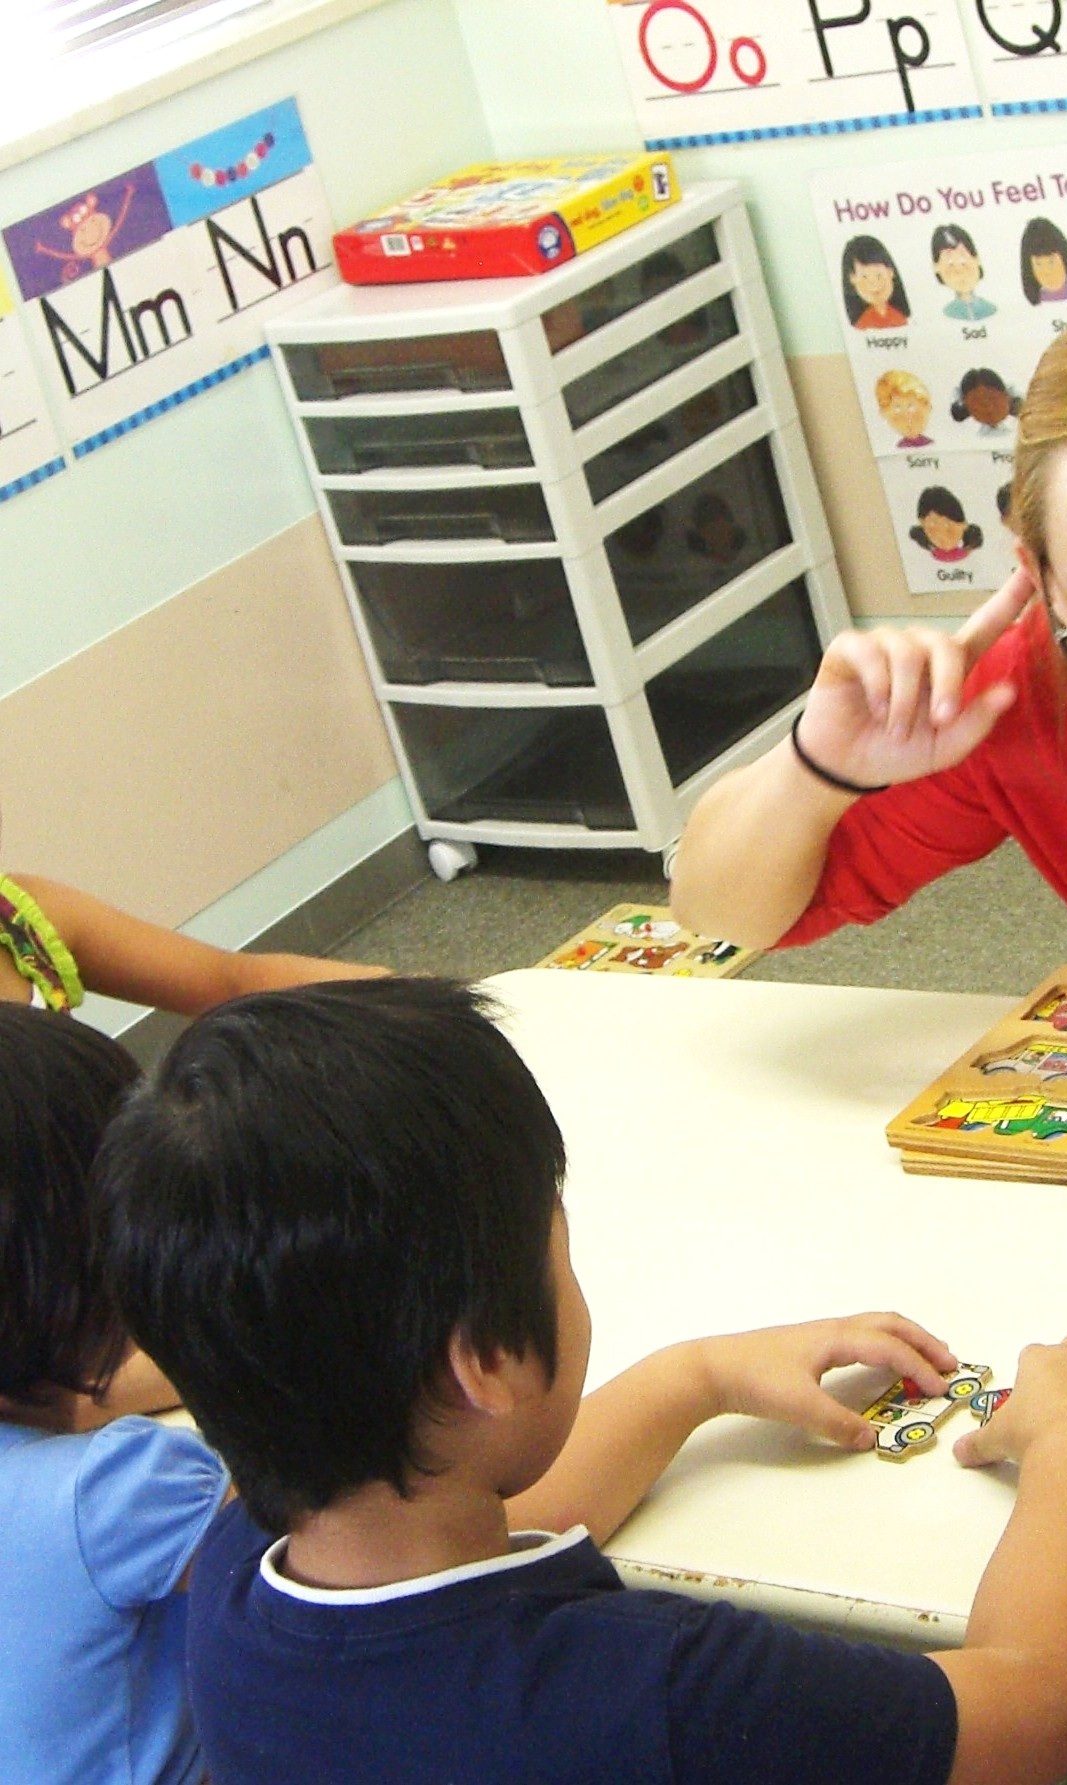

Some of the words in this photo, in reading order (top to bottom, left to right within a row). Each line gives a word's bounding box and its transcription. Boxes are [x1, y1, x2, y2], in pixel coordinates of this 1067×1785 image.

[833, 197, 891, 223] How
[897, 191, 933, 216] Do
[937, 186, 985, 211] You
[991, 175, 1046, 205] Feel
[205, 193, 318, 313] Nn
[38, 264, 193, 396] Mm
[961, 325, 988, 342] Sad
[866, 334, 909, 350] Happy
[906, 454, 940, 470] Sorry
[936, 568, 974, 585] Guilty
